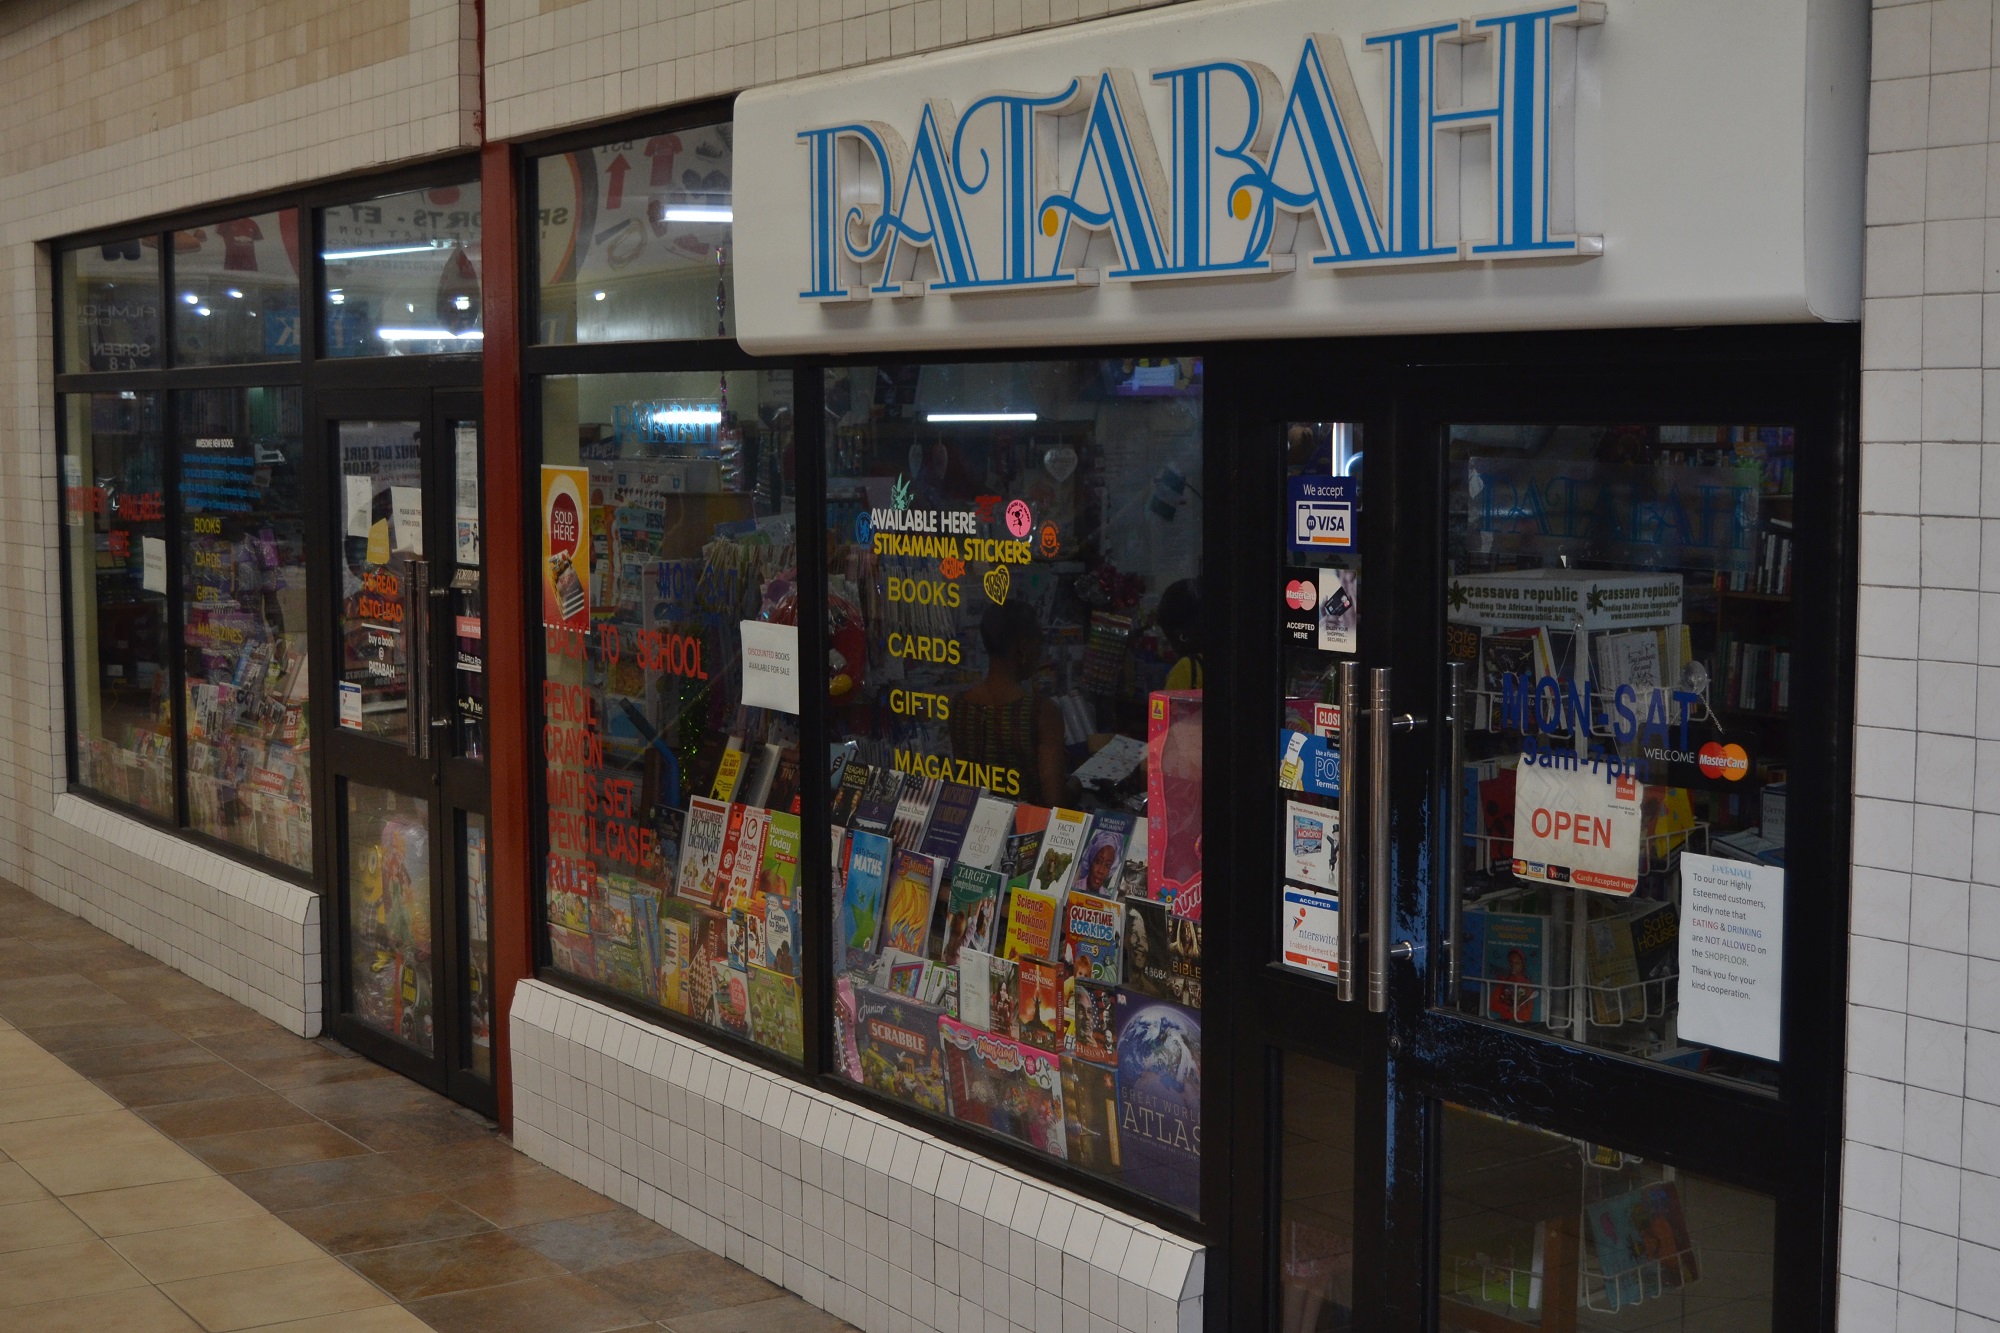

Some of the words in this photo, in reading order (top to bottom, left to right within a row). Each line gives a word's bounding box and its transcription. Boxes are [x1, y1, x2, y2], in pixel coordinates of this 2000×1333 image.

[797, 8, 1580, 301] PATABAH
[1303, 483, 1316, 496] We
[1317, 485, 1344, 499] accept
[194, 518, 221, 535] BOOKS
[554, 510, 573, 524] SOLD
[870, 507, 938, 533] AVAILABLE
[941, 510, 977, 535] HERE
[1317, 515, 1345, 531] VISA
[553, 524, 575, 542] HERE
[873, 532, 960, 559] STIKAMANIA
[963, 537, 1032, 565] STICKERS
[195, 550, 222, 569] CARDS
[363, 572, 375, 591] TO
[376, 573, 398, 595] READ
[887, 576, 961, 609] BOOKS
[1602, 585, 1641, 601] cassava
[1642, 582, 1681, 602] republic
[1467, 585, 1520, 600] cassava
[1523, 586, 1579, 603] republic
[359, 595, 368, 617] IS
[368, 597, 379, 619] TO
[382, 600, 404, 622] LEAD
[1468, 601, 1494, 612] feeding
[1495, 602, 1507, 611] the
[1508, 602, 1534, 611] African
[1535, 604, 1577, 614] imagination
[1480, 610, 1565, 622] www.cassavarepublic.biz
[1610, 610, 1671, 621] www.cassavarepublic.biz
[1622, 603, 1630, 611] the
[1630, 602, 1650, 611] African
[196, 622, 245, 645] MAGAZINES
[1286, 621, 1316, 631] ACCEPTED
[1293, 631, 1309, 640] HERE
[368, 633, 378, 646] buy
[887, 632, 961, 666] CARDS
[545, 620, 588, 661] BACK
[597, 623, 620, 665] TO
[636, 628, 708, 680] SCHOOL
[747, 647, 775, 659] DISCOUNTED
[775, 651, 790, 661] BOOKS
[368, 660, 395, 679] PATABAH
[748, 662, 770, 673] AVAILABLE
[770, 665, 780, 674] FOR
[780, 667, 790, 677] SALE
[542, 679, 597, 726] PENCIL
[889, 688, 950, 720] GIFTS
[1502, 672, 1697, 752] MON-SAT
[542, 723, 603, 771] CRAYON
[1315, 749, 1323, 757] Use
[1523, 735, 1651, 785] 9am-7pm
[1644, 747, 1695, 764] WELCOME
[1699, 754, 1748, 770] MasterCard
[842, 773, 867, 785] THATCHER
[846, 763, 864, 776] REAGAN
[894, 748, 1021, 796] MAGAZINES
[546, 767, 599, 813] MATHS
[602, 777, 635, 819] SET
[1617, 787, 1634, 796] GTBank
[690, 818, 722, 840] PICTURE
[743, 817, 758, 840] 10
[770, 823, 799, 840] Homework
[973, 825, 999, 838] PLATTER
[1057, 822, 1076, 833] FACTS
[1531, 807, 1612, 849] OPEN
[547, 808, 603, 857] PENCIL
[606, 820, 652, 869] CASE
[687, 833, 721, 854] DICTIONARY
[768, 835, 791, 854] Today
[969, 842, 990, 854] GOLD
[1050, 834, 1076, 847] FICTION
[547, 850, 600, 900] RULER
[853, 853, 883, 877] MATHS
[897, 855, 911, 876] 5
[908, 859, 932, 877] Minute
[952, 875, 984, 895] Comprehension
[958, 866, 991, 885] TARGET
[1530, 866, 1542, 874] VISA
[1576, 872, 1593, 883] Cards
[1593, 875, 1620, 888] Accepted
[1621, 879, 1636, 890] Here
[1693, 872, 1702, 882] To
[1703, 877, 1716, 885] our
[1717, 878, 1729, 887] our
[1730, 879, 1752, 892] Highly
[1016, 894, 1044, 913] Science
[1299, 897, 1331, 908] ACCEPTED
[1692, 888, 1727, 902] Esteemed
[1727, 895, 1766, 910] customers,
[770, 912, 786, 923] Learn
[1015, 910, 1048, 932] Workbook
[1692, 903, 1714, 916] kindly
[1715, 907, 1730, 918] note
[1732, 910, 1747, 921] that
[775, 921, 788, 933] Read
[1071, 919, 1089, 936] FOR
[1090, 922, 1114, 941] KIDS
[1644, 911, 1674, 935] Safe
[1692, 918, 1719, 931] EATING
[1719, 923, 1726, 932] &
[1727, 924, 1762, 940] DRINKING
[1016, 928, 1050, 950] Beginners
[1289, 940, 1308, 952] Enabled
[1308, 944, 1328, 957] Payment
[1692, 935, 1704, 944] are
[1705, 935, 1721, 947] NOT
[1721, 938, 1757, 954] ALLOWED
[1757, 947, 1767, 955] on
[1692, 948, 1704, 959] the
[1704, 949, 1749, 967] SHOPFLOOR.
[1172, 961, 1201, 979] BIBLE
[1692, 964, 1713, 977] Thank
[1713, 969, 1726, 981] you
[1728, 971, 1738, 982] for
[1739, 976, 1756, 987] your
[1692, 979, 1706, 991] kind
[1707, 983, 1751, 1000] cooperation.
[870, 1021, 926, 1052] SCRABBLE
[1121, 1086, 1158, 1109] GREAT
